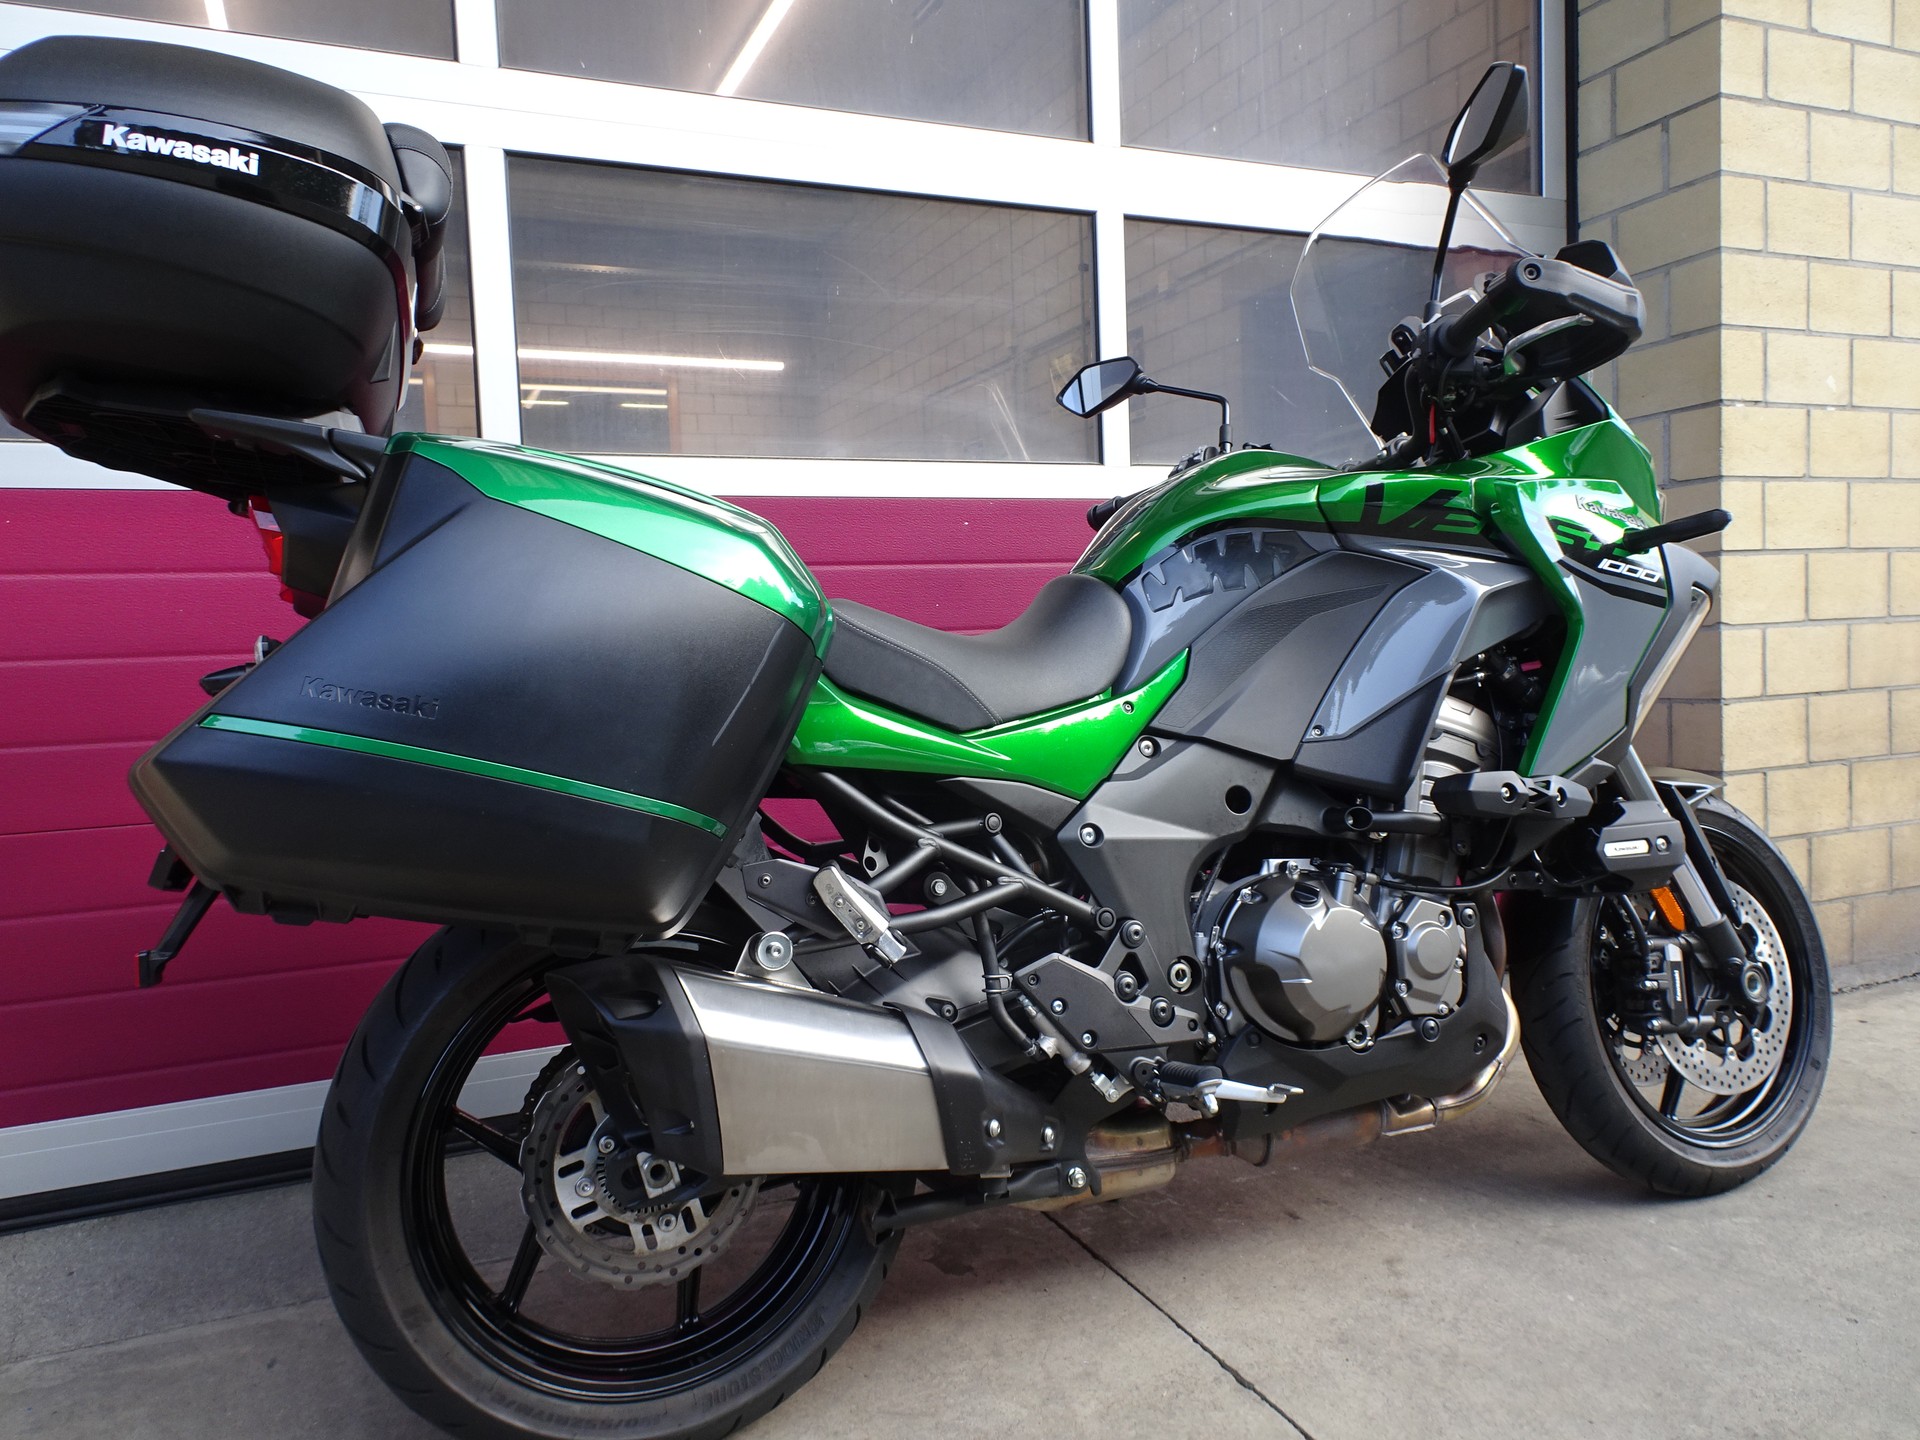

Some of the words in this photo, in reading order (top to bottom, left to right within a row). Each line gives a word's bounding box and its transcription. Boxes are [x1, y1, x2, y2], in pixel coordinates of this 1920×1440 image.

[102, 124, 259, 176] Kawasaki
[1598, 558, 1662, 583] 1000
[300, 675, 441, 720] Kawasaki
